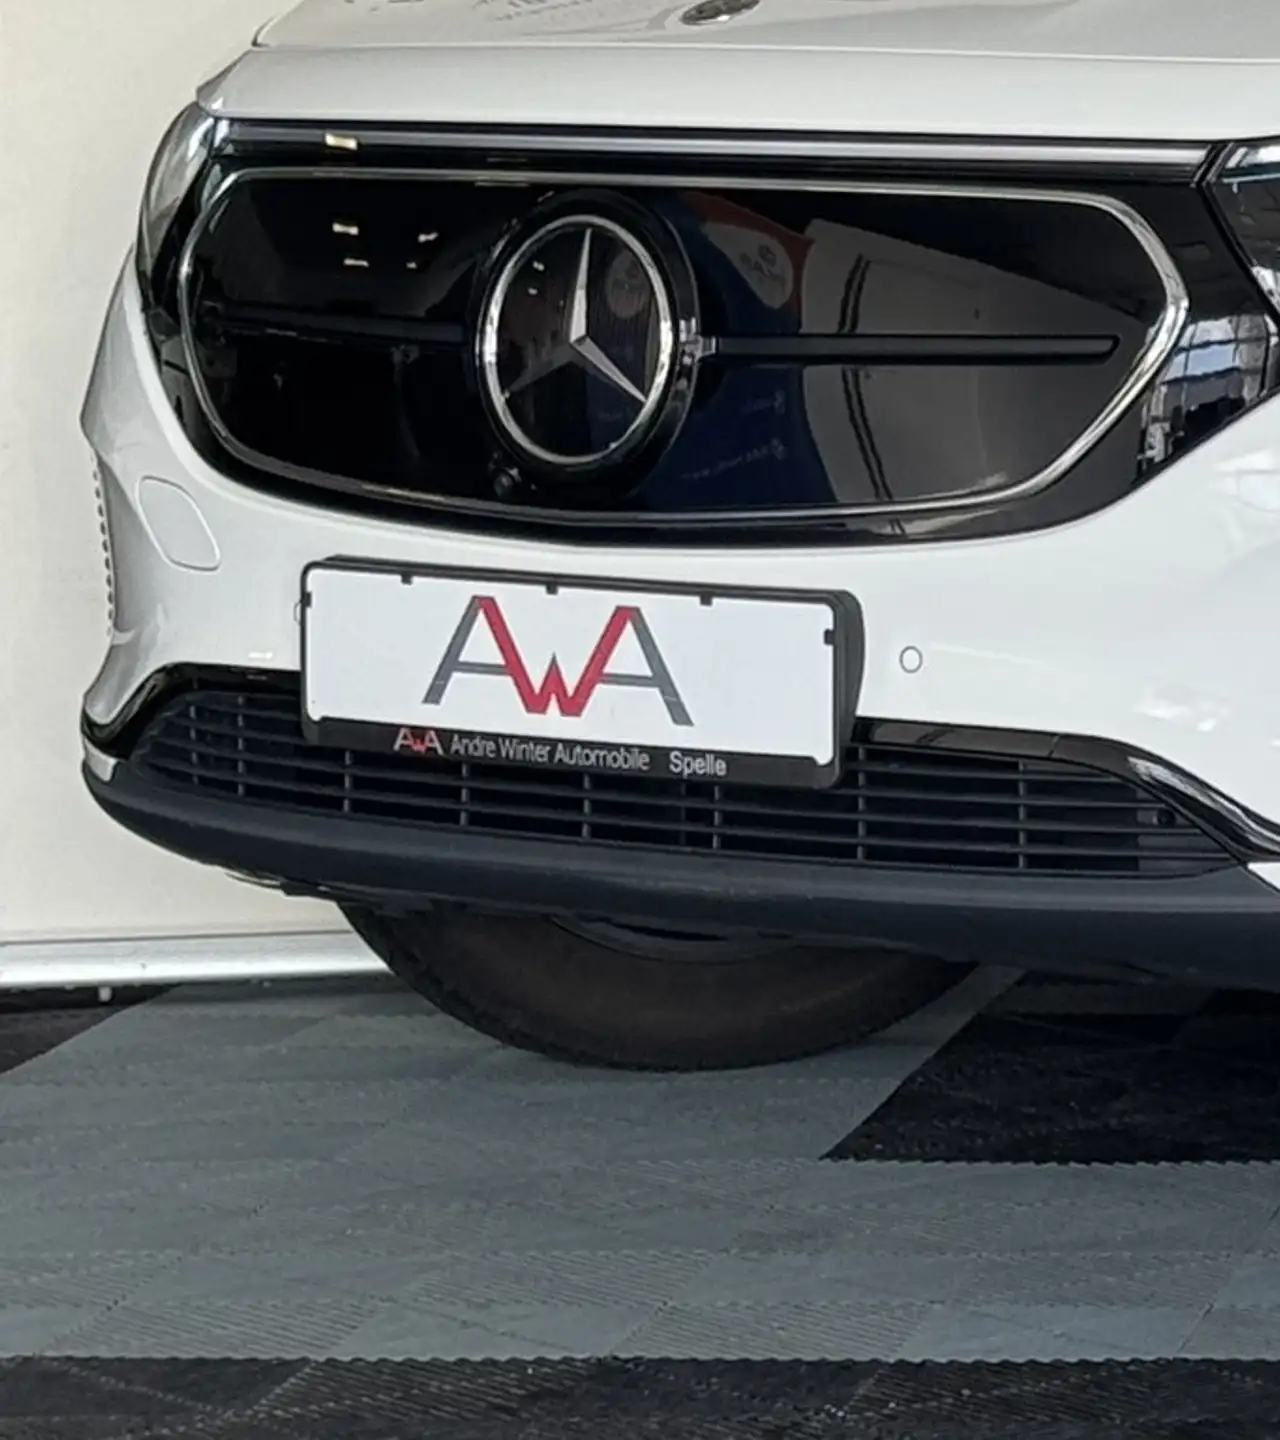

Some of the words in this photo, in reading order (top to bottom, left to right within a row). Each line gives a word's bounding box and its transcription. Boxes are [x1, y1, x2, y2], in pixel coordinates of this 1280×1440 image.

[450, 733, 497, 758] Andre
[499, 737, 551, 762] Winter
[554, 742, 650, 771] Automobile
[669, 750, 727, 779] Spelle
